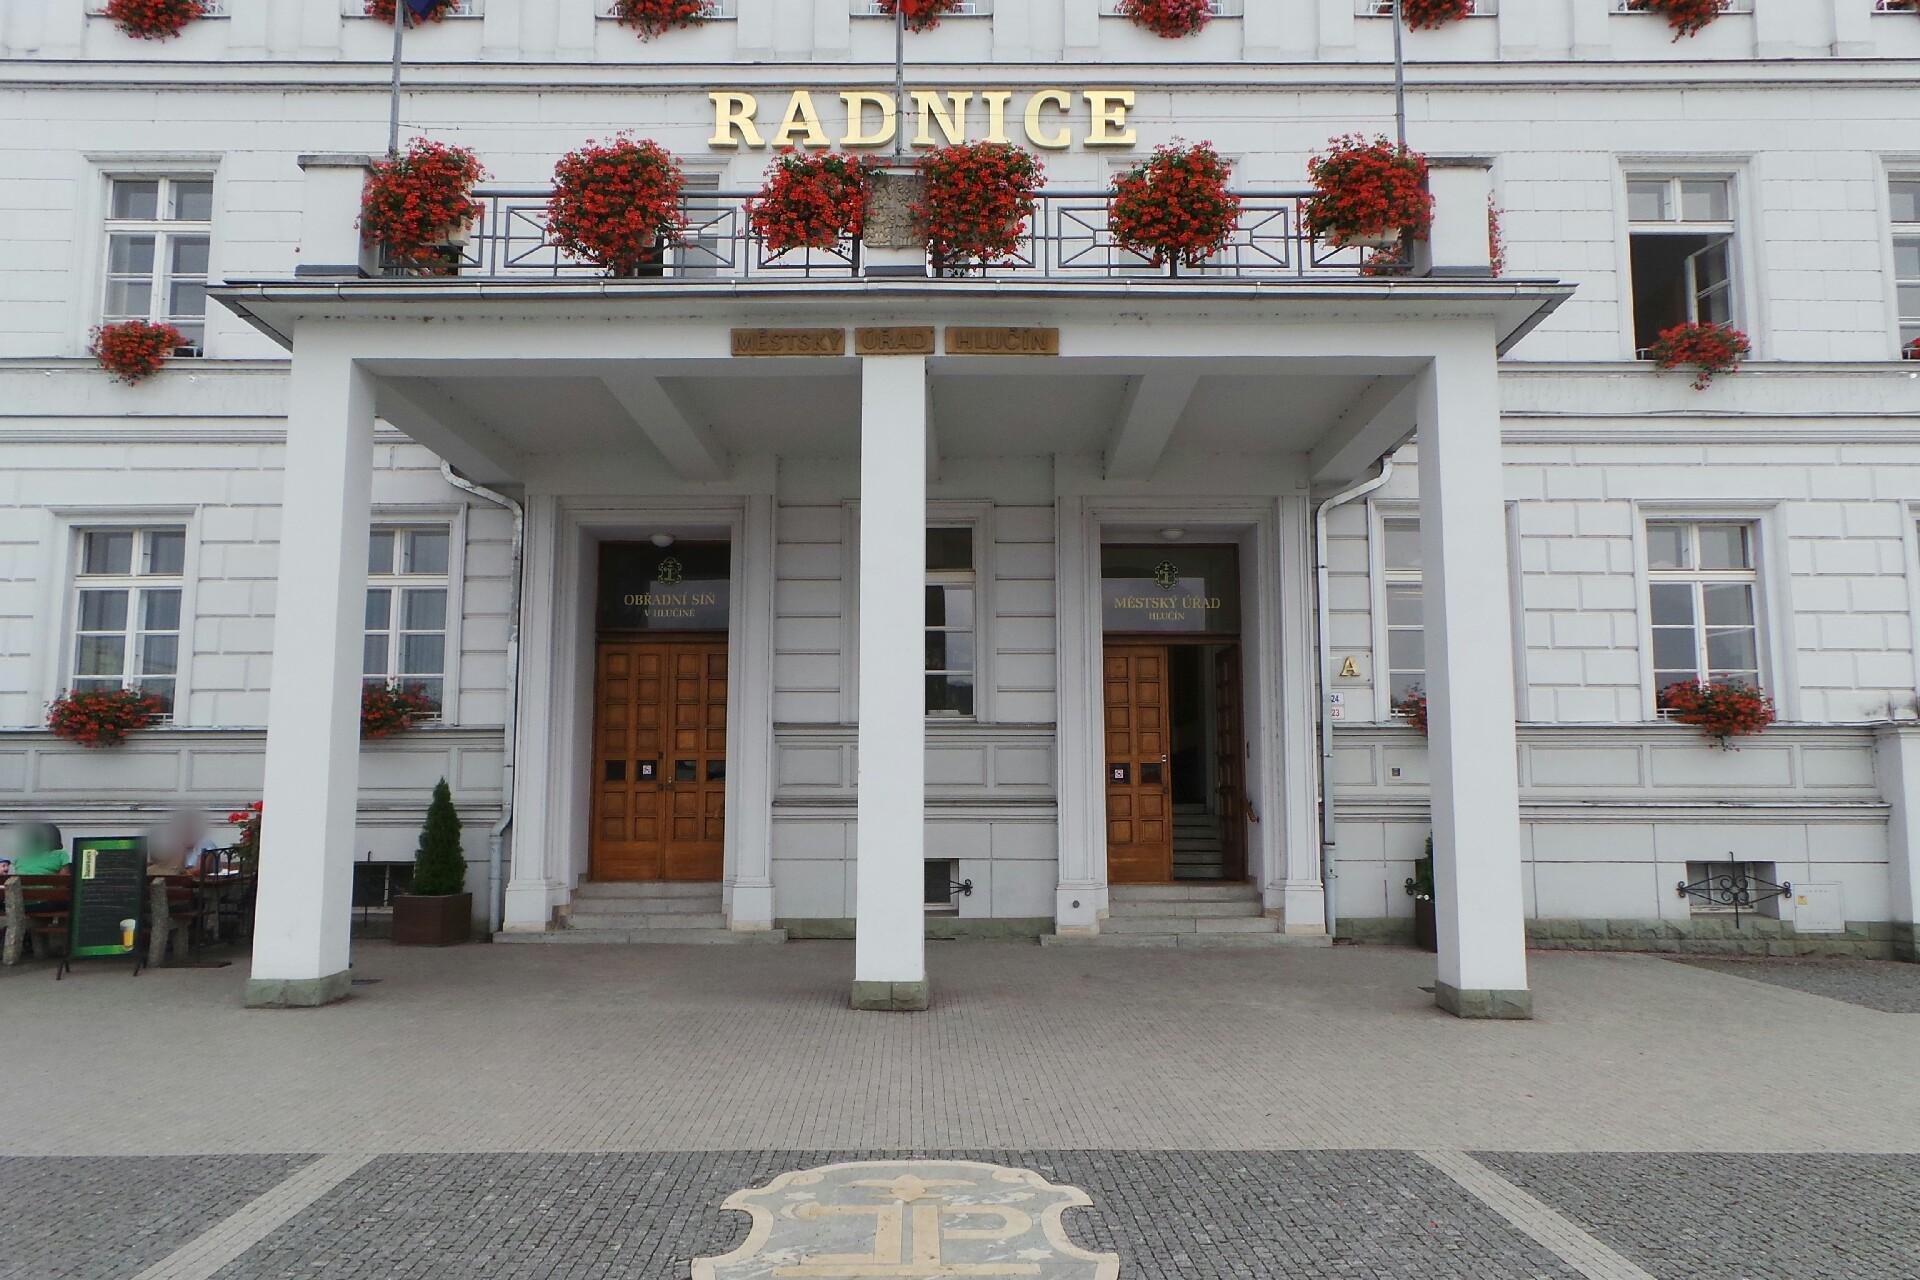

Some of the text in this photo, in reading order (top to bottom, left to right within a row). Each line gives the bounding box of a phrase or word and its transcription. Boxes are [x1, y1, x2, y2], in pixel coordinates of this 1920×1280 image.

[707, 90, 1138, 150] RADNICE
[734, 327, 1049, 352] MĚSTSKÝ ÚŘAD HLUČÍN
[624, 592, 687, 606] OBŘADNÍ
[1114, 594, 1221, 609] MĚSTSKÝ ÚŘAD
[1148, 611, 1185, 621] HLUČÍN
[1339, 655, 1360, 677] A
